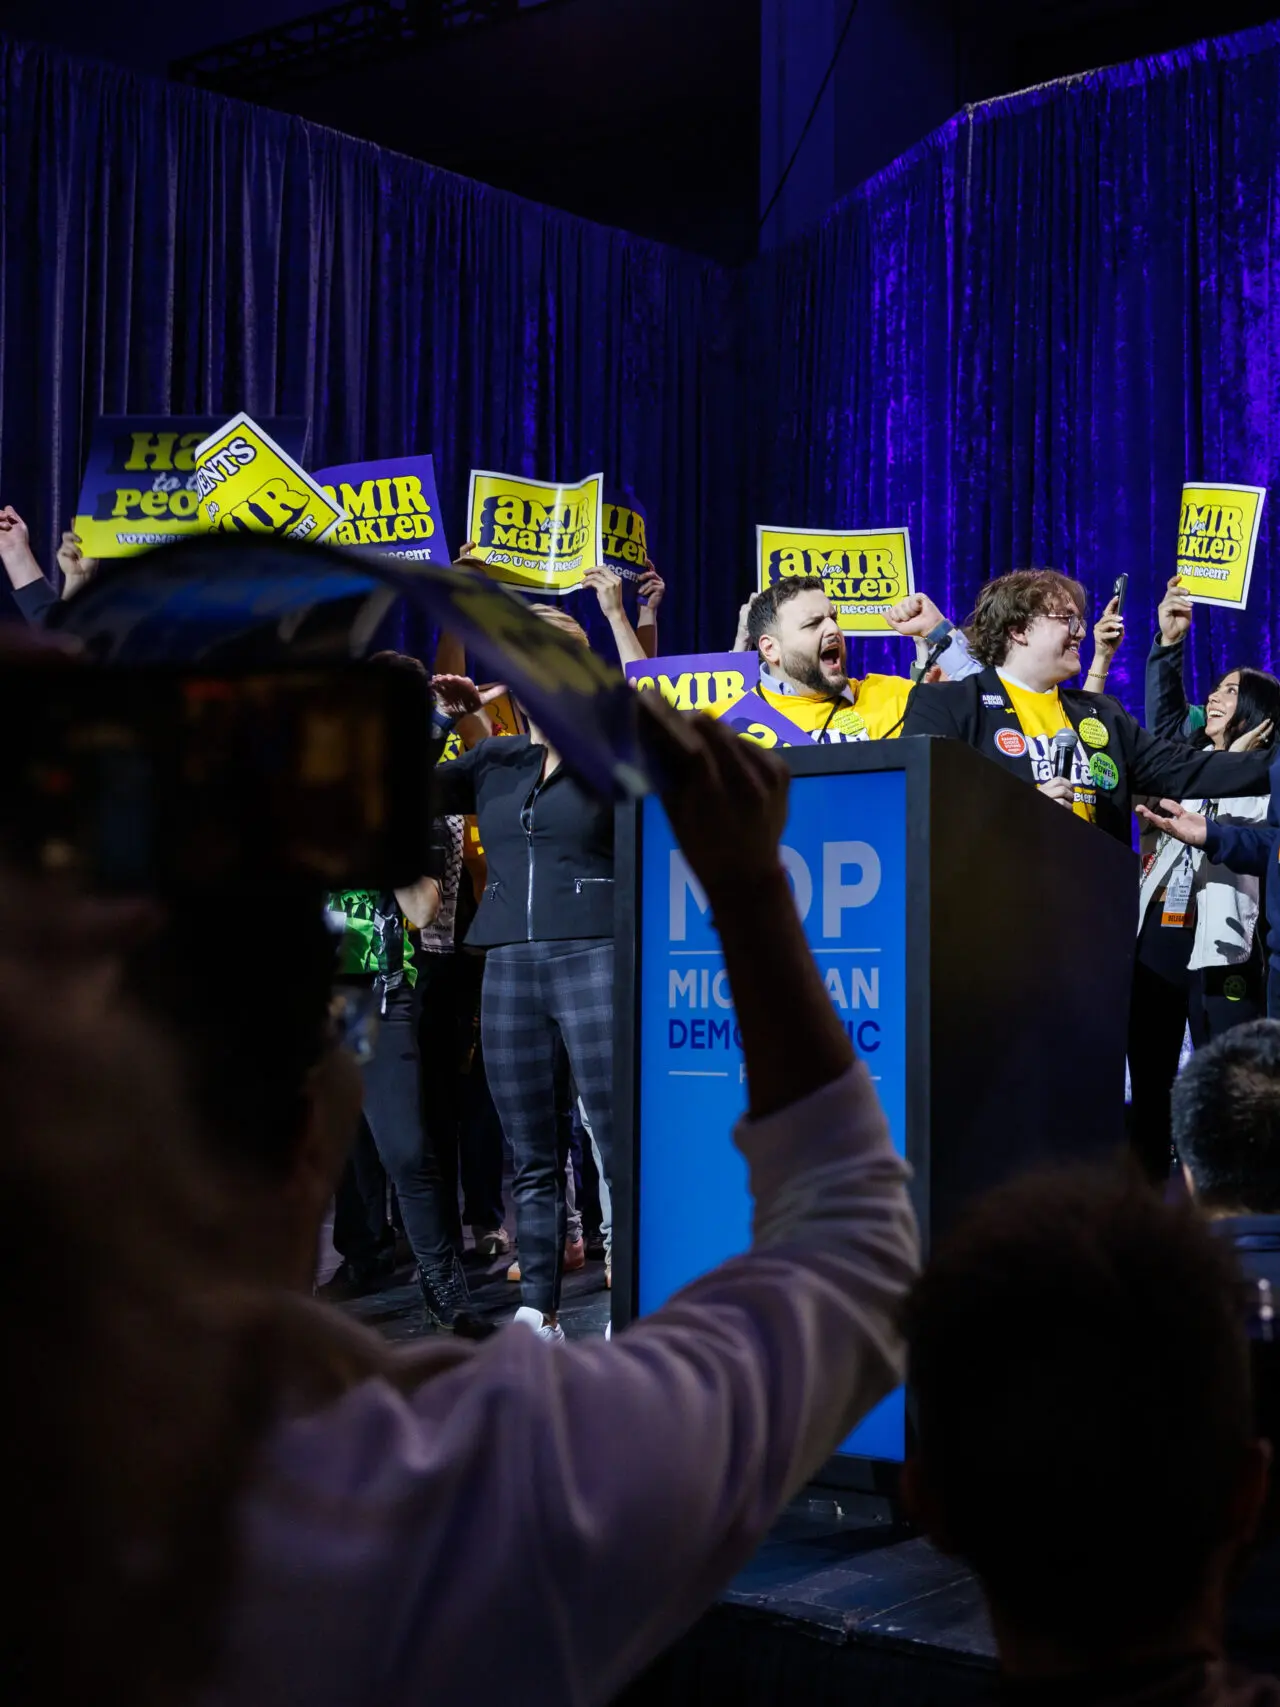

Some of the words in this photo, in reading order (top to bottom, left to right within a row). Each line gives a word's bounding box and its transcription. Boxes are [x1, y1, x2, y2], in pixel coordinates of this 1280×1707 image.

[197, 436, 257, 503] ENTS
[322, 475, 431, 521] MIR
[485, 550, 511, 565] for
[512, 556, 523, 567] U
[821, 564, 843, 577] for
[1183, 564, 1193, 576] M
